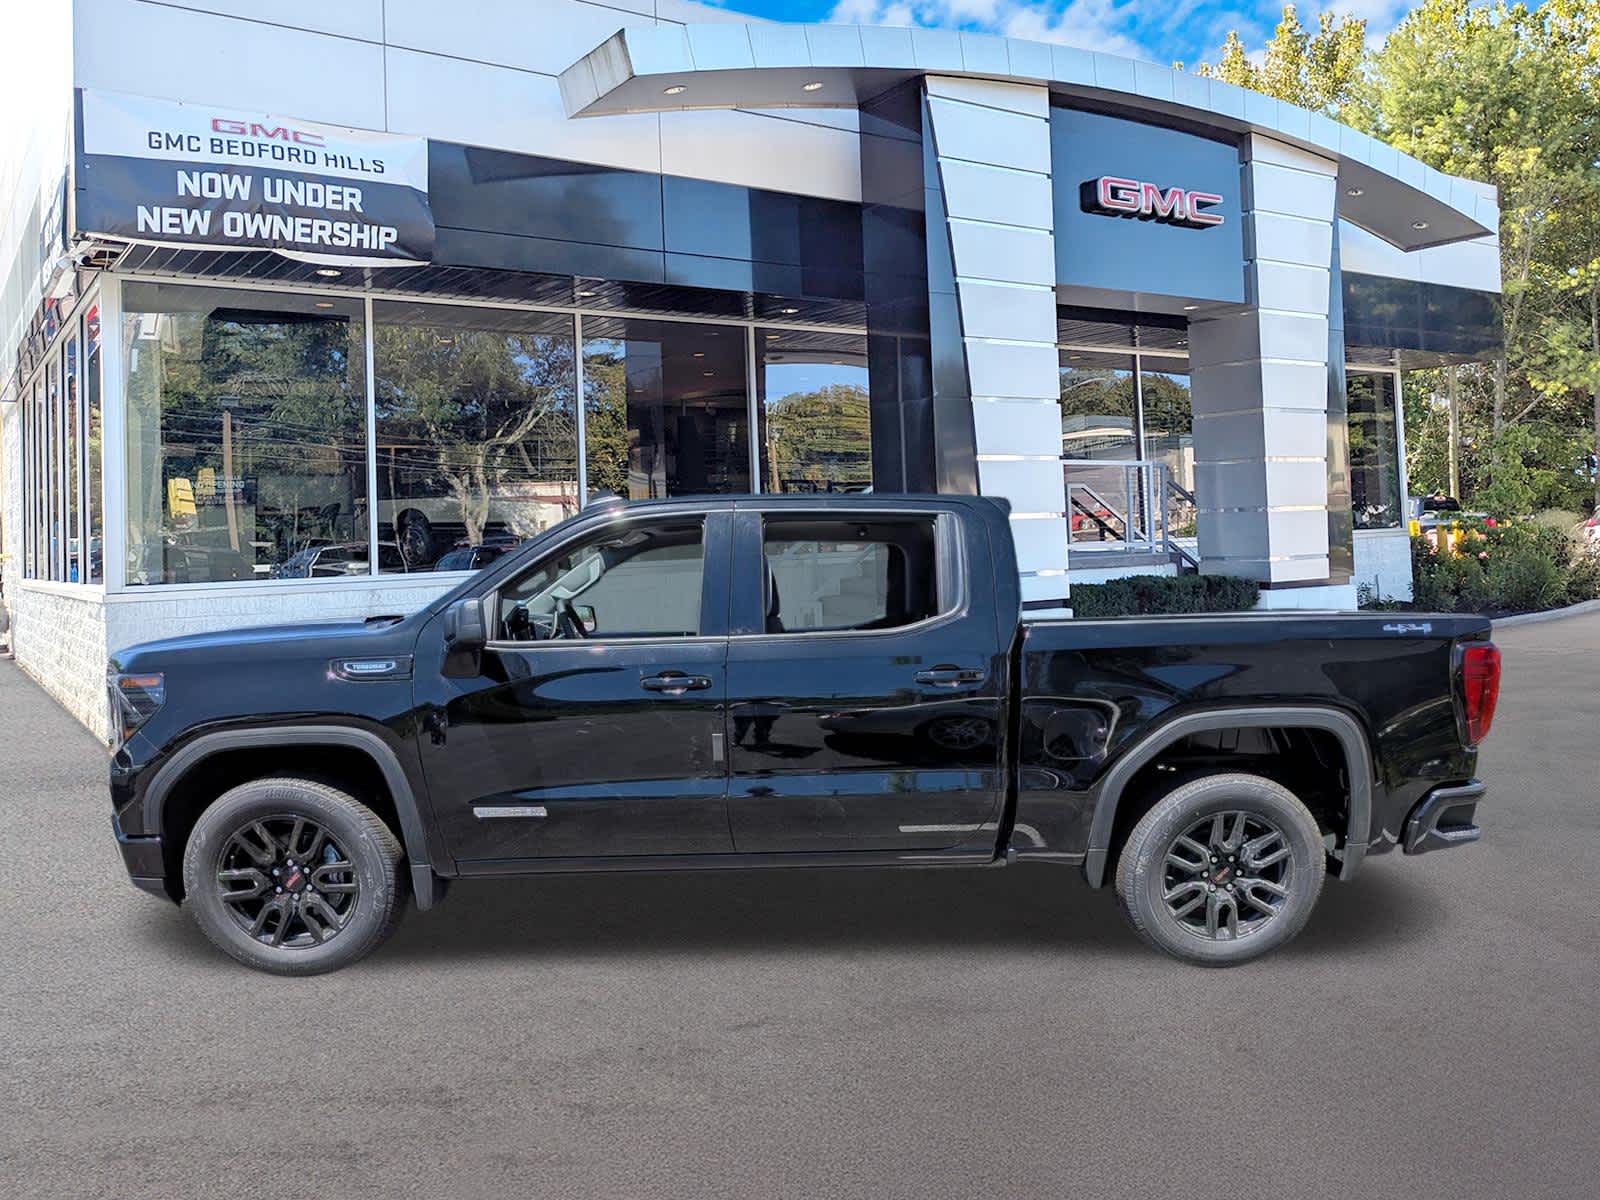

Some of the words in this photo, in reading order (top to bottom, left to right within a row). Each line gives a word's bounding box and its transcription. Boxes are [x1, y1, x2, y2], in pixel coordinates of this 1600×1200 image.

[148, 131, 201, 152] GMC
[210, 138, 316, 165] BEDFORD
[325, 153, 385, 174] HILLS
[211, 117, 326, 147] GMC
[177, 170, 252, 200] NOW
[264, 177, 364, 213] UNDER
[1096, 176, 1225, 224] GMC
[136, 205, 210, 236] NEW
[223, 211, 398, 250] OWNERSHIP
